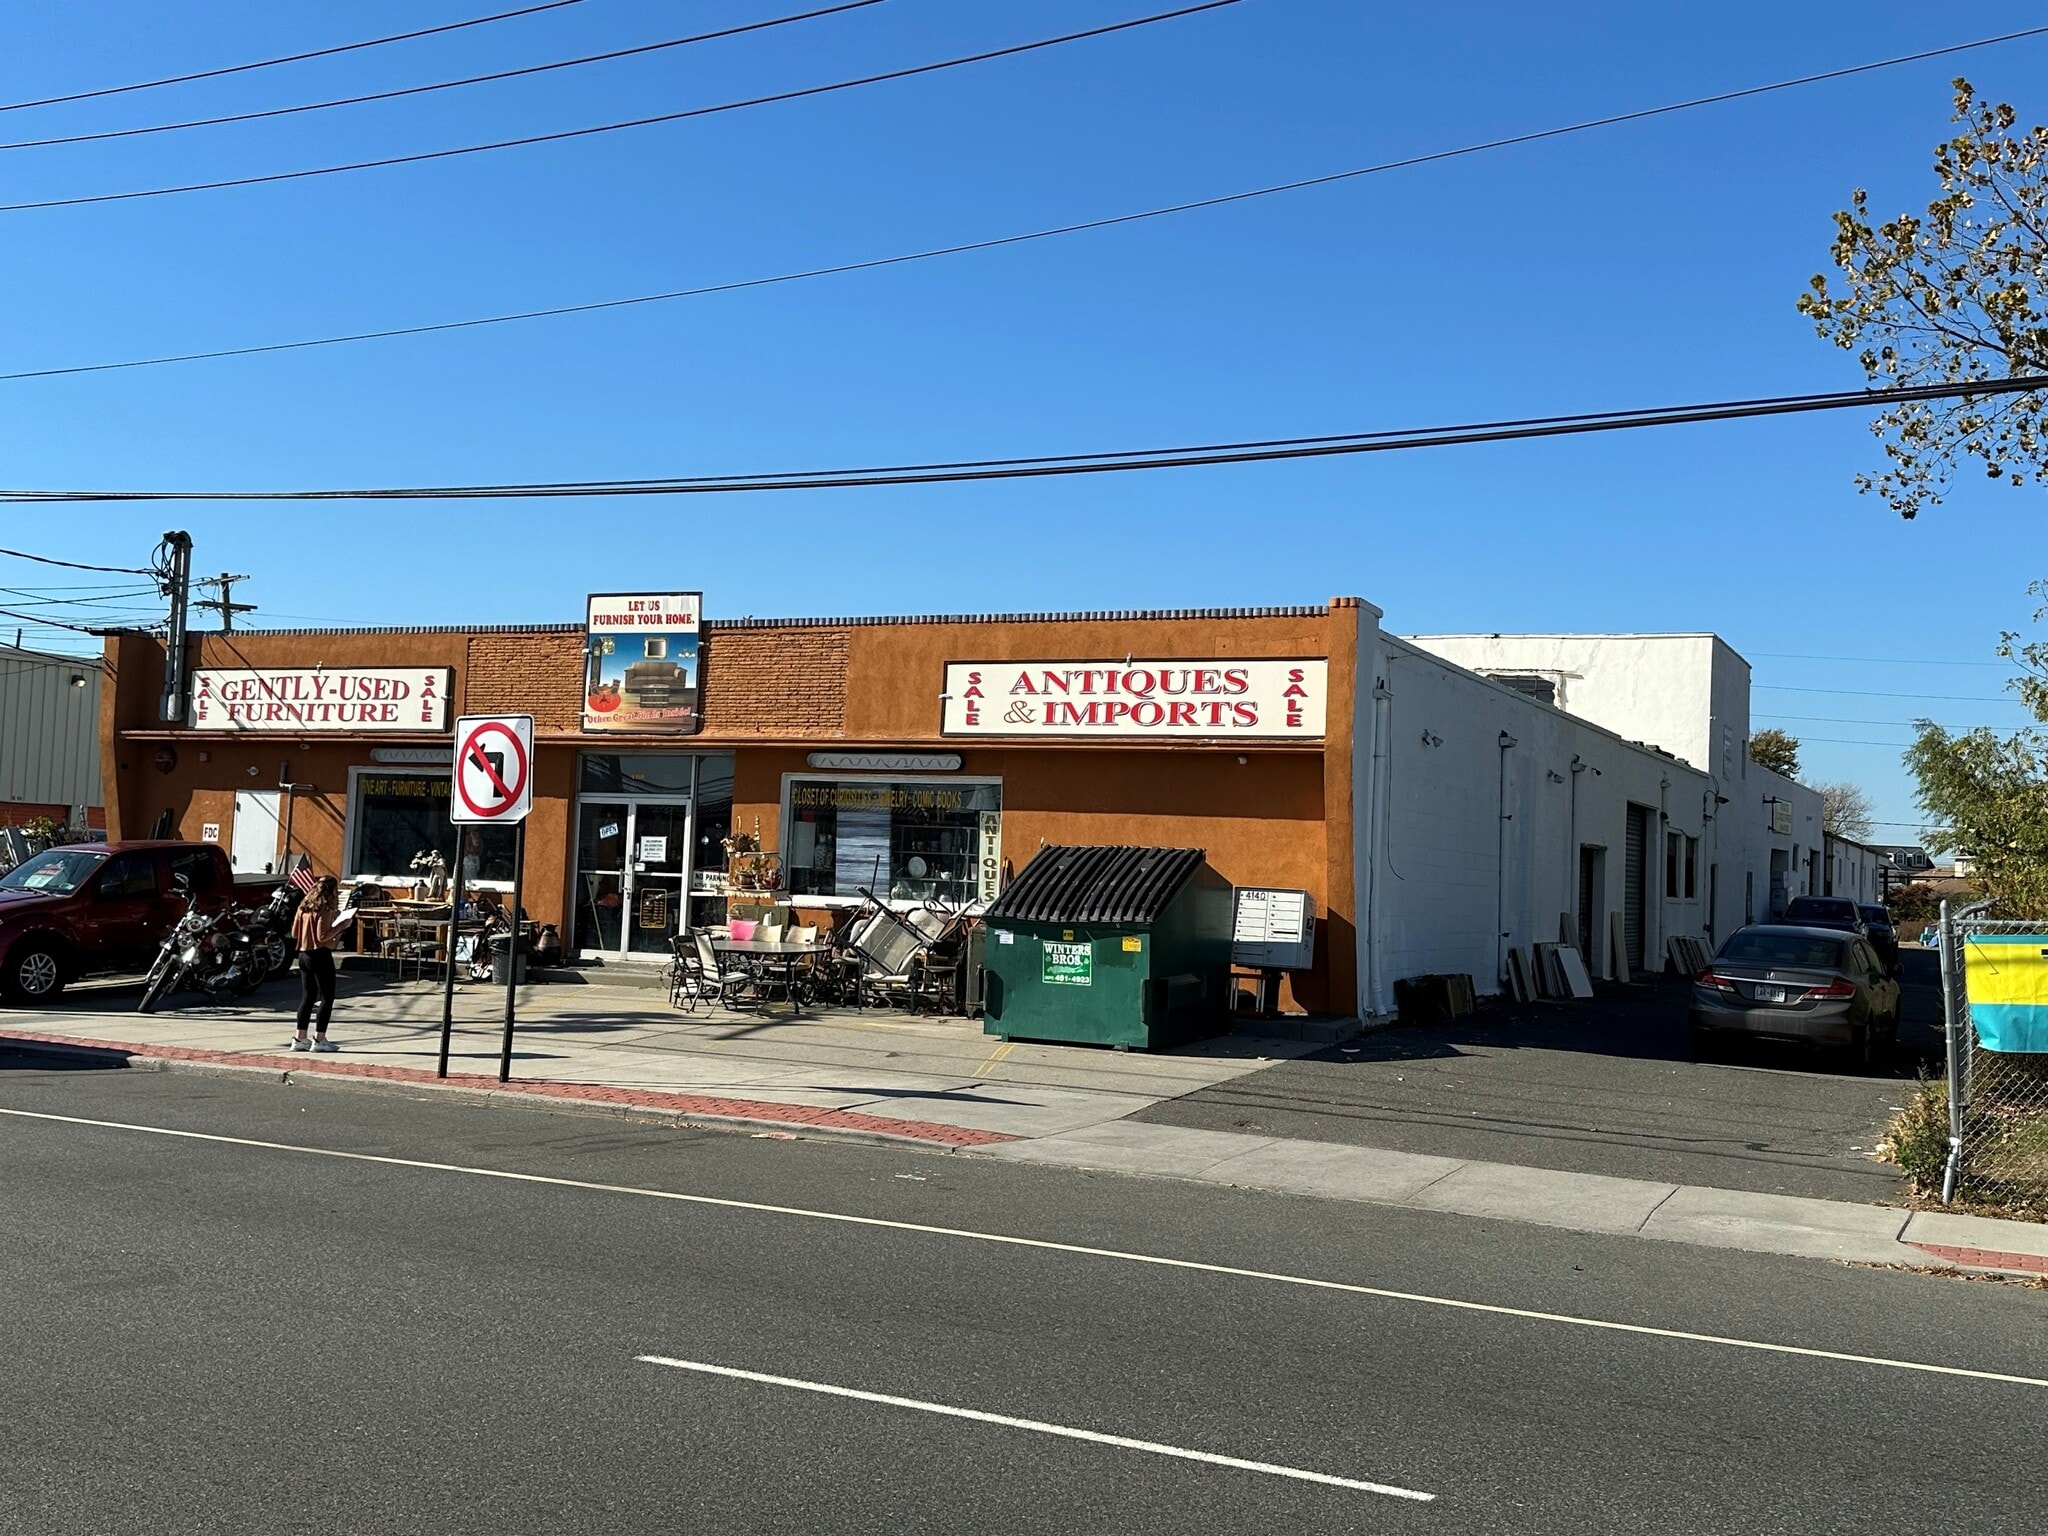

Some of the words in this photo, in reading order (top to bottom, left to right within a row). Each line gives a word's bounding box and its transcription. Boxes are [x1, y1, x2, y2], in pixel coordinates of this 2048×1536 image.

[628, 600, 645, 612] LET
[647, 600, 660, 612] US
[593, 614, 635, 625] FURNISH
[637, 613, 663, 625] YOUR
[665, 613, 695, 625] HOME.
[220, 675, 411, 701] GENTLY-USED
[1008, 668, 1249, 700] ANTIQUES
[197, 676, 212, 721] SALE
[420, 675, 437, 723] SALE
[963, 671, 985, 726] SALE
[1282, 668, 1309, 728] SALE
[227, 703, 400, 722] FURNITURE
[588, 714, 610, 724] Other
[1003, 701, 1037, 724] &
[1042, 700, 1259, 727] IMPORTS
[375, 780, 388, 795] ART
[391, 780, 426, 796] FURNITURE
[792, 787, 819, 805] CLOSET
[820, 788, 830, 805] OF
[912, 790, 934, 808] COMIC
[937, 790, 962, 808] BOOKS
[204, 826, 218, 839] FDC
[601, 825, 617, 837] OPEN
[982, 814, 998, 902] ANTIQUES
[1044, 944, 1091, 955] WINTERS
